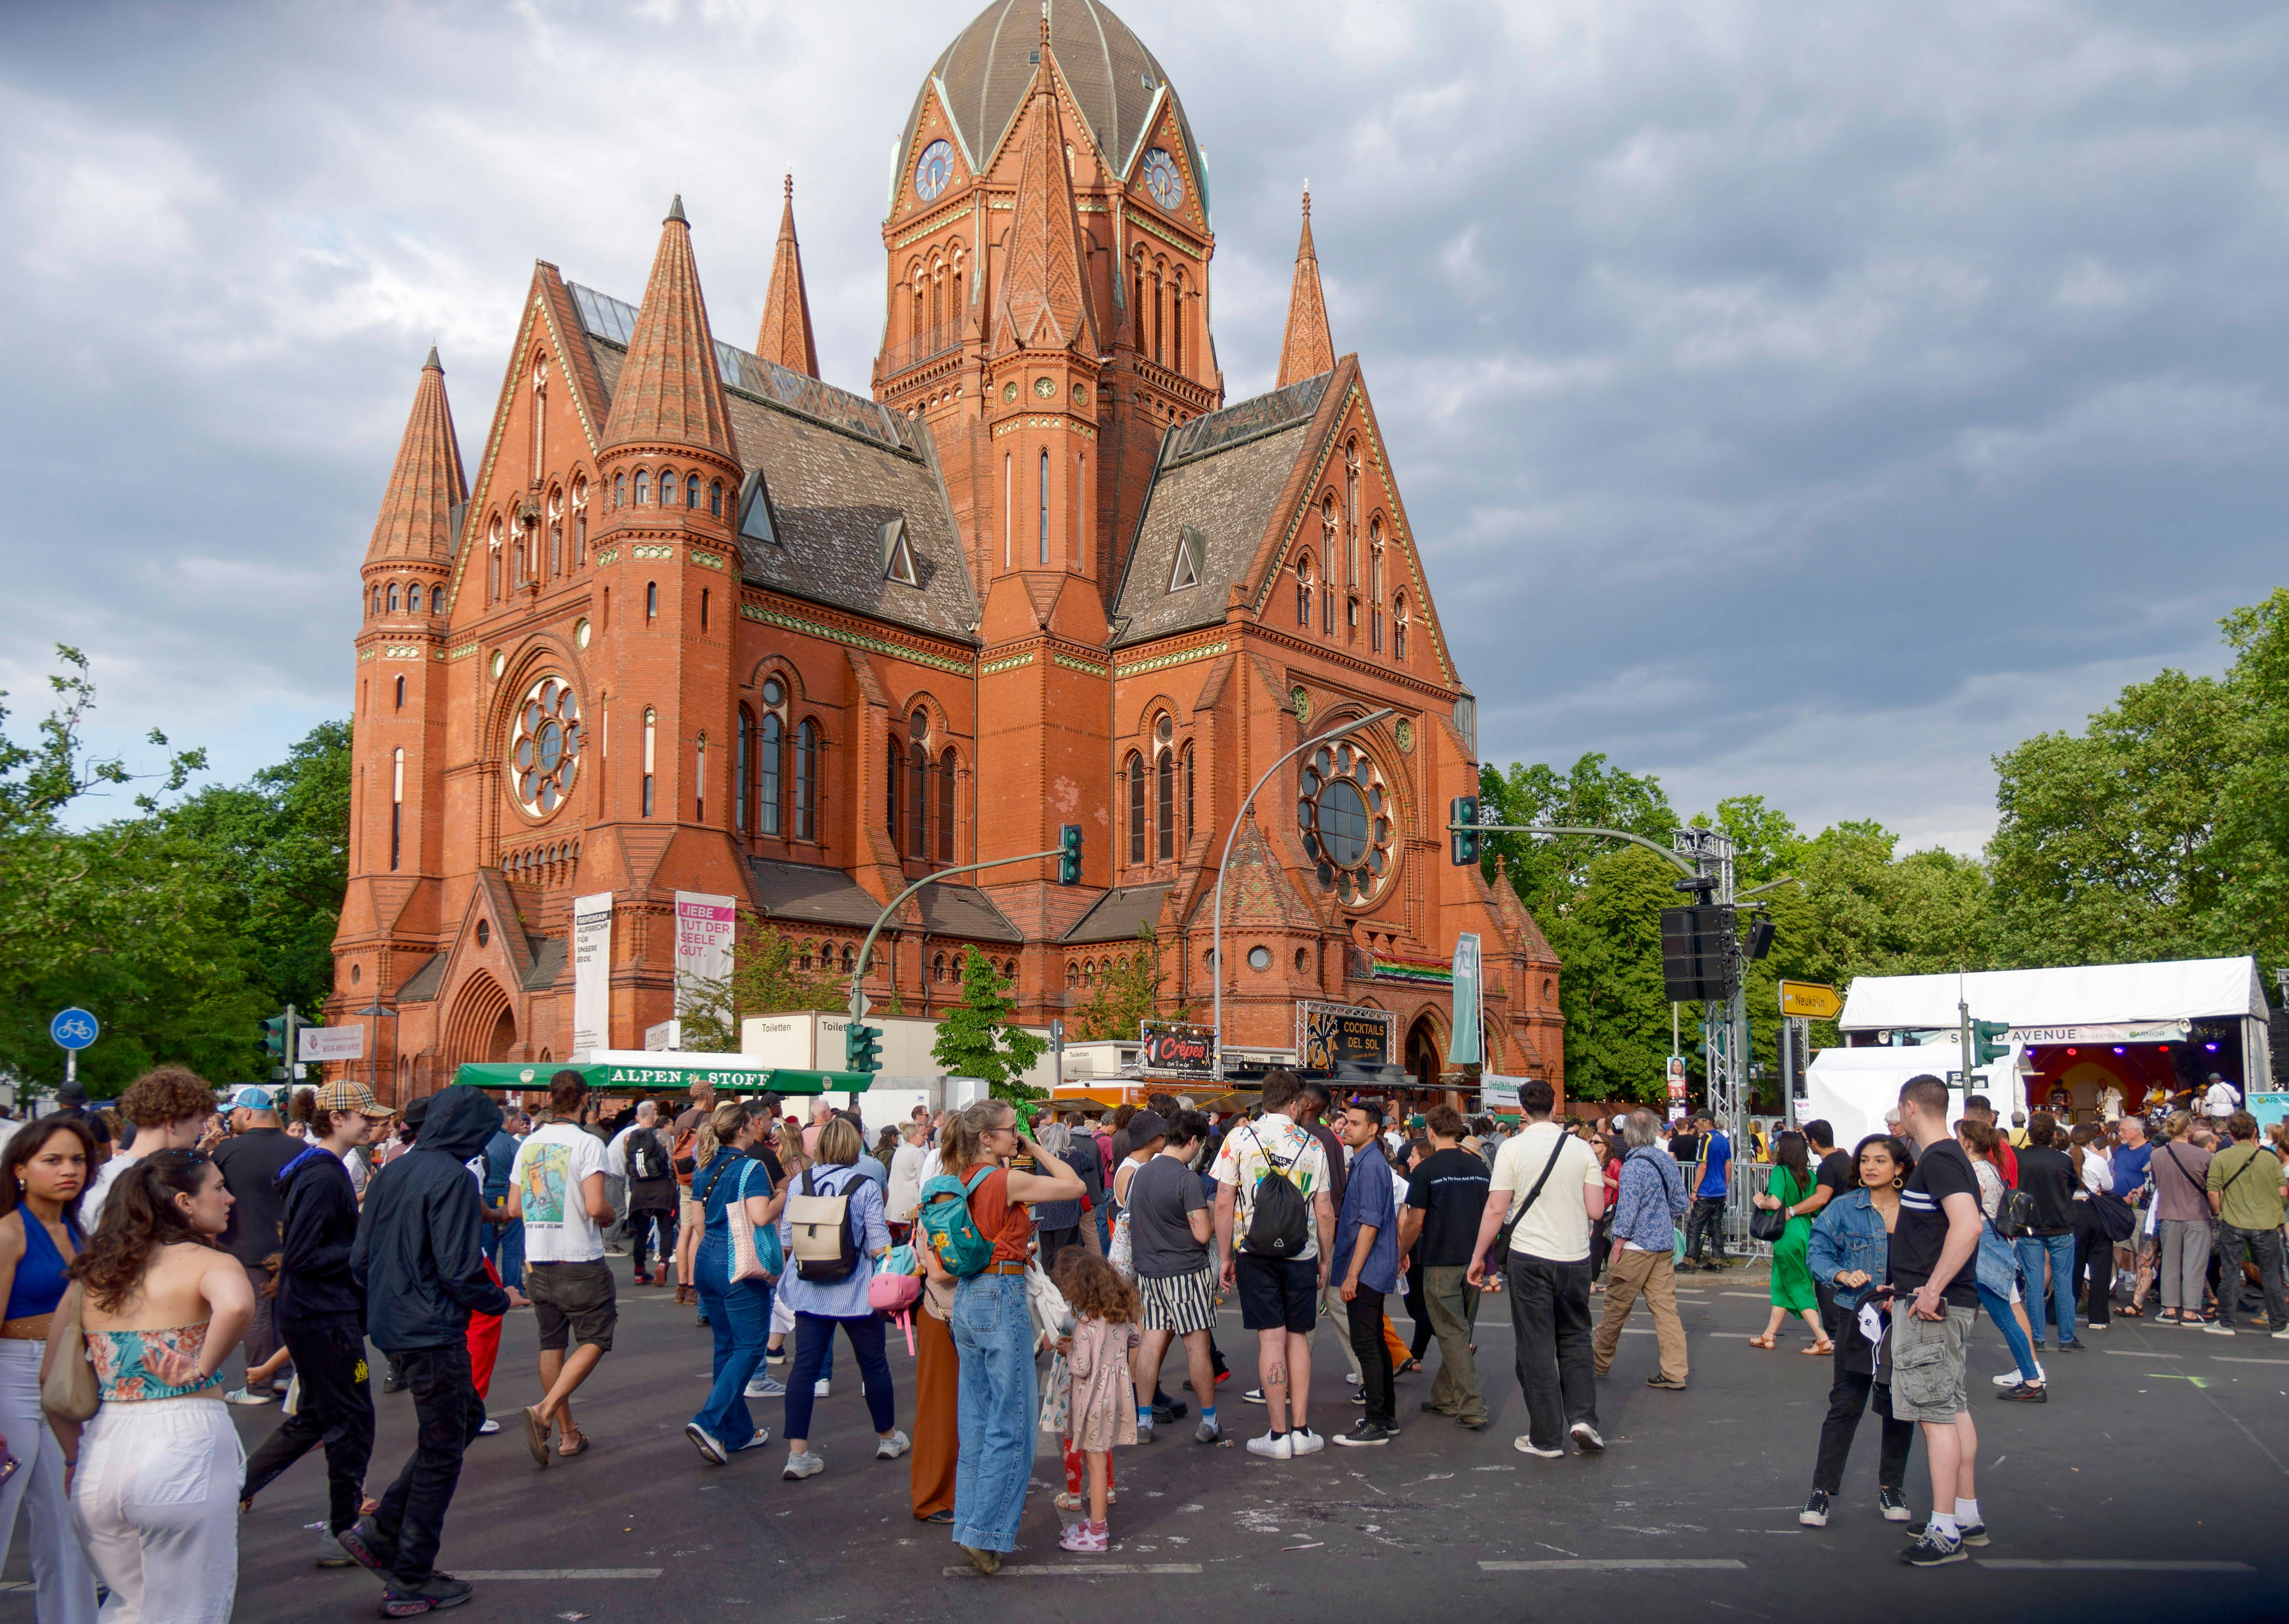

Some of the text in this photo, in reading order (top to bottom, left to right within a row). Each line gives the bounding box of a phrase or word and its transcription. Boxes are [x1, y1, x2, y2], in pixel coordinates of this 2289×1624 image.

[680, 905, 714, 918] LIEBE
[681, 919, 730, 934] TUT DER
[680, 932, 715, 945] SEELE
[680, 945, 706, 957] GUT.
[1795, 994, 1824, 1007] Neukölln
[762, 1024, 791, 1032] Toiletten
[822, 1022, 847, 1031] Toilet
[1344, 1021, 1384, 1036] COCKTAILS
[2012, 1029, 2076, 1041] AVENUE
[1161, 1037, 1205, 1060] Crêpes
[1348, 1036, 1380, 1050] DEL SOL
[611, 1069, 770, 1086] ALPEN STOFF
[1271, 1155, 1287, 1164] HELLO
